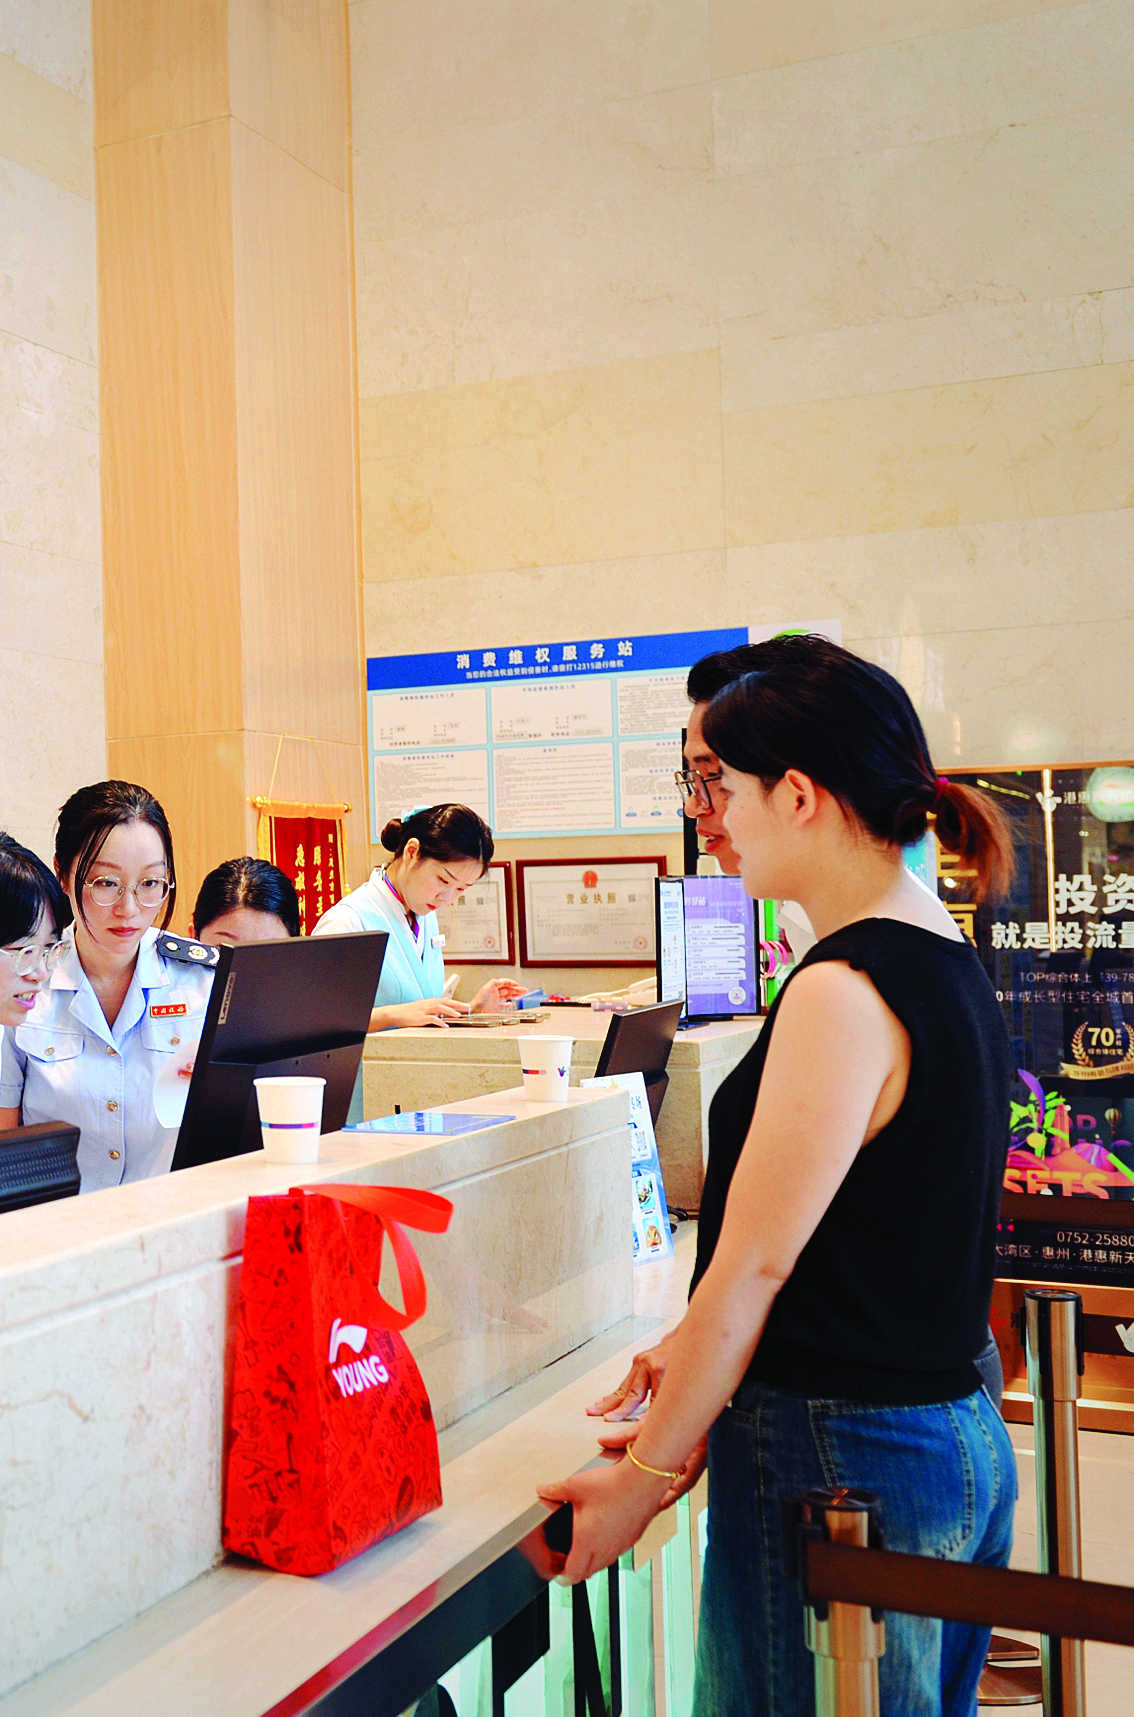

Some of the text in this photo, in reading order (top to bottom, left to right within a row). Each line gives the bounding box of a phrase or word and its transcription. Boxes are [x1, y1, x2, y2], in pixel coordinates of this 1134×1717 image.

[456, 640, 634, 669] 消费维权服务站
[566, 892, 617, 905] 营业执照
[1054, 873, 1134, 915] 投资
[1087, 1027, 1115, 1047] 70
[332, 1354, 389, 1398] YOUNG
